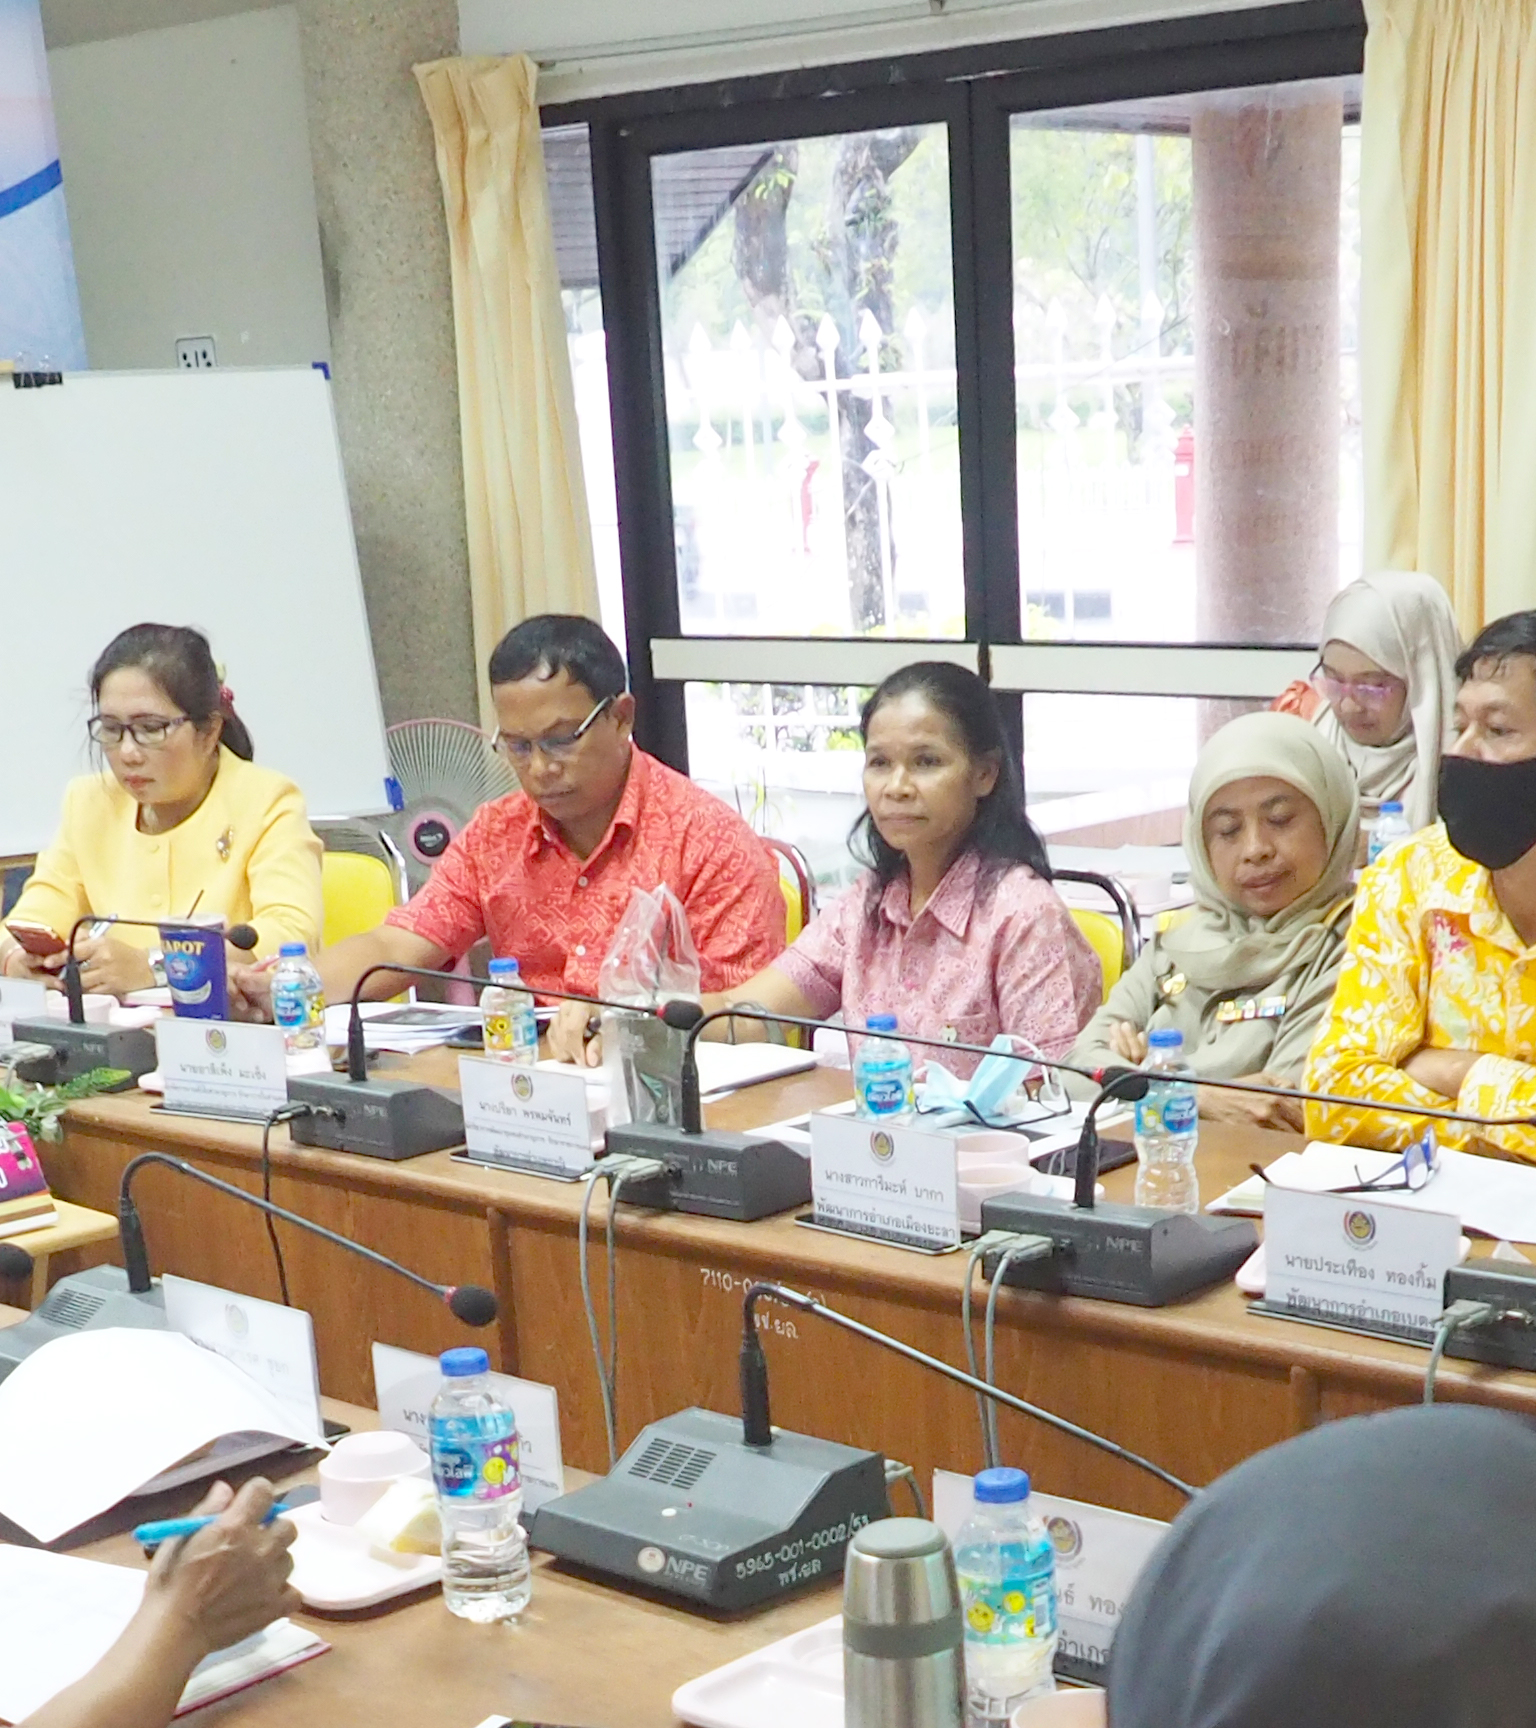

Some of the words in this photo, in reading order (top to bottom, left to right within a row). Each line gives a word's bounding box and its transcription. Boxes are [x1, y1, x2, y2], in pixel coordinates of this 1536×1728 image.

[1284, 1253, 1375, 1281] นายประเทือง
[665, 1555, 710, 1583] NPE
